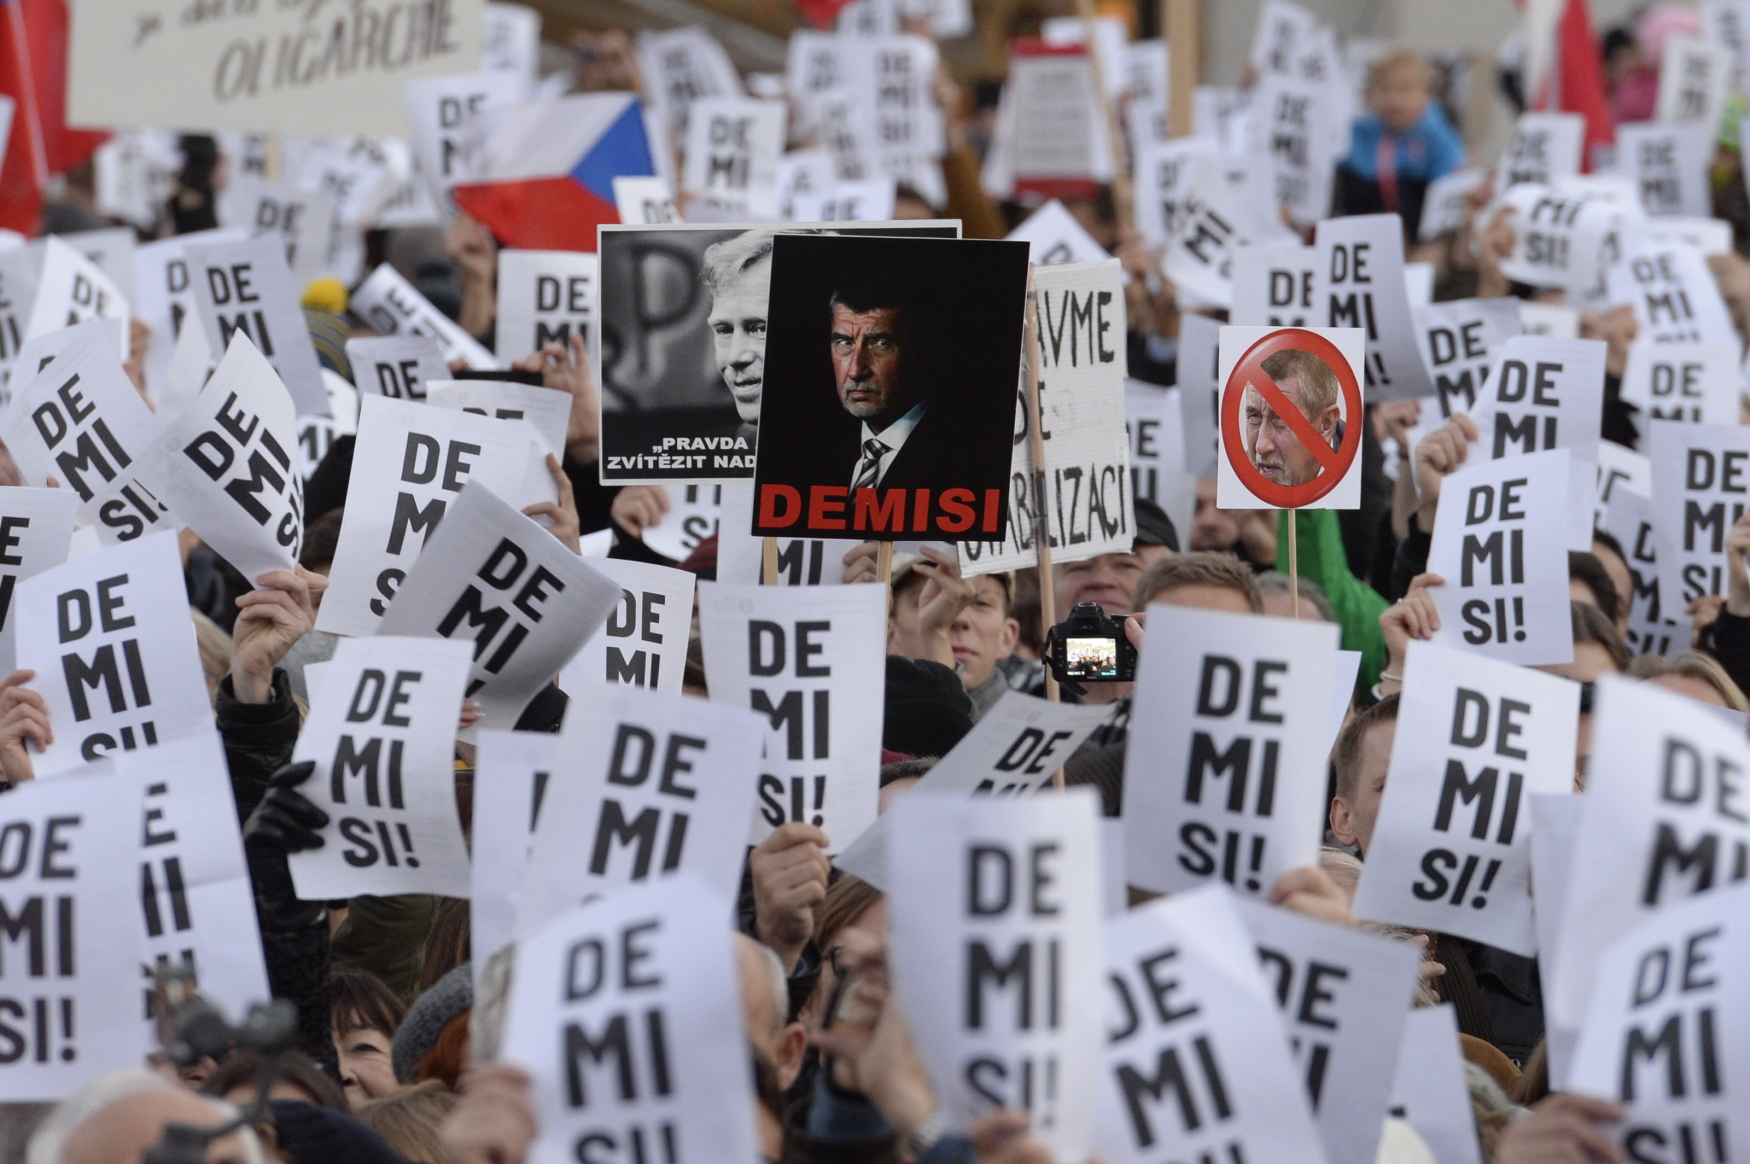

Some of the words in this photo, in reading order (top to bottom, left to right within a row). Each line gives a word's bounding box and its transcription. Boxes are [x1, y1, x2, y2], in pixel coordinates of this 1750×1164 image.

[708, 113, 752, 145] DE
[705, 152, 749, 190] MI
[256, 196, 303, 232] DE
[1184, 208, 1234, 265] MI
[1331, 245, 1372, 284] DE
[1524, 231, 1569, 270] SI!
[1632, 252, 1678, 285] DE
[207, 263, 260, 305] DE
[370, 289, 415, 336] DE
[536, 277, 590, 313] DE
[1645, 289, 1692, 322] MI
[1330, 294, 1378, 340] MI
[1428, 322, 1486, 367] DE
[375, 360, 427, 399] DE
[1497, 360, 1563, 407] DE
[1652, 363, 1703, 398] DE
[32, 373, 96, 450] DE
[183, 391, 259, 481] DE
[1492, 411, 1558, 460] MI
[56, 417, 132, 503] MI
[224, 428, 290, 526] MI
[401, 431, 481, 493] DE
[607, 454, 707, 470] ZVÍTĚZIT
[714, 455, 755, 469] NAD
[652, 437, 748, 455] „PRAVDA
[1686, 448, 1749, 493] DE
[386, 491, 446, 555] M
[757, 483, 1001, 534] DEMISI
[1466, 478, 1527, 526] DE
[477, 537, 565, 623] DE
[1461, 529, 1524, 587] MI
[57, 573, 136, 644] DE
[436, 584, 530, 675] MI
[606, 588, 666, 645] DE
[1462, 597, 1526, 645] SI!
[606, 647, 661, 692] MI
[748, 620, 831, 677] DE
[61, 638, 152, 722] MI
[346, 668, 423, 727] DE
[1196, 654, 1289, 724] DE
[750, 689, 830, 760] MI
[993, 726, 1074, 774] DE
[1450, 687, 1531, 760] DE
[331, 735, 405, 809] MI
[607, 723, 707, 799] DE
[1184, 731, 1281, 817] MI
[1660, 737, 1749, 823] DE
[757, 774, 826, 828] SI!
[1433, 758, 1524, 845] MI
[0, 816, 83, 880] DE
[338, 817, 420, 868] SI!
[589, 799, 689, 882] MI
[1177, 821, 1266, 891] SI!
[1640, 822, 1749, 907] MI
[968, 843, 1060, 917] DE
[1413, 848, 1503, 910] SI!
[0, 896, 75, 977] MI
[565, 920, 661, 1001] DE
[1631, 926, 1722, 1008] DE
[968, 938, 1060, 1030] MI
[0, 997, 77, 1063] SI!
[565, 1010, 671, 1107] MI
[1620, 1008, 1721, 1104] MI
[967, 1057, 1057, 1126] SI!
[1116, 1036, 1232, 1148] MI
